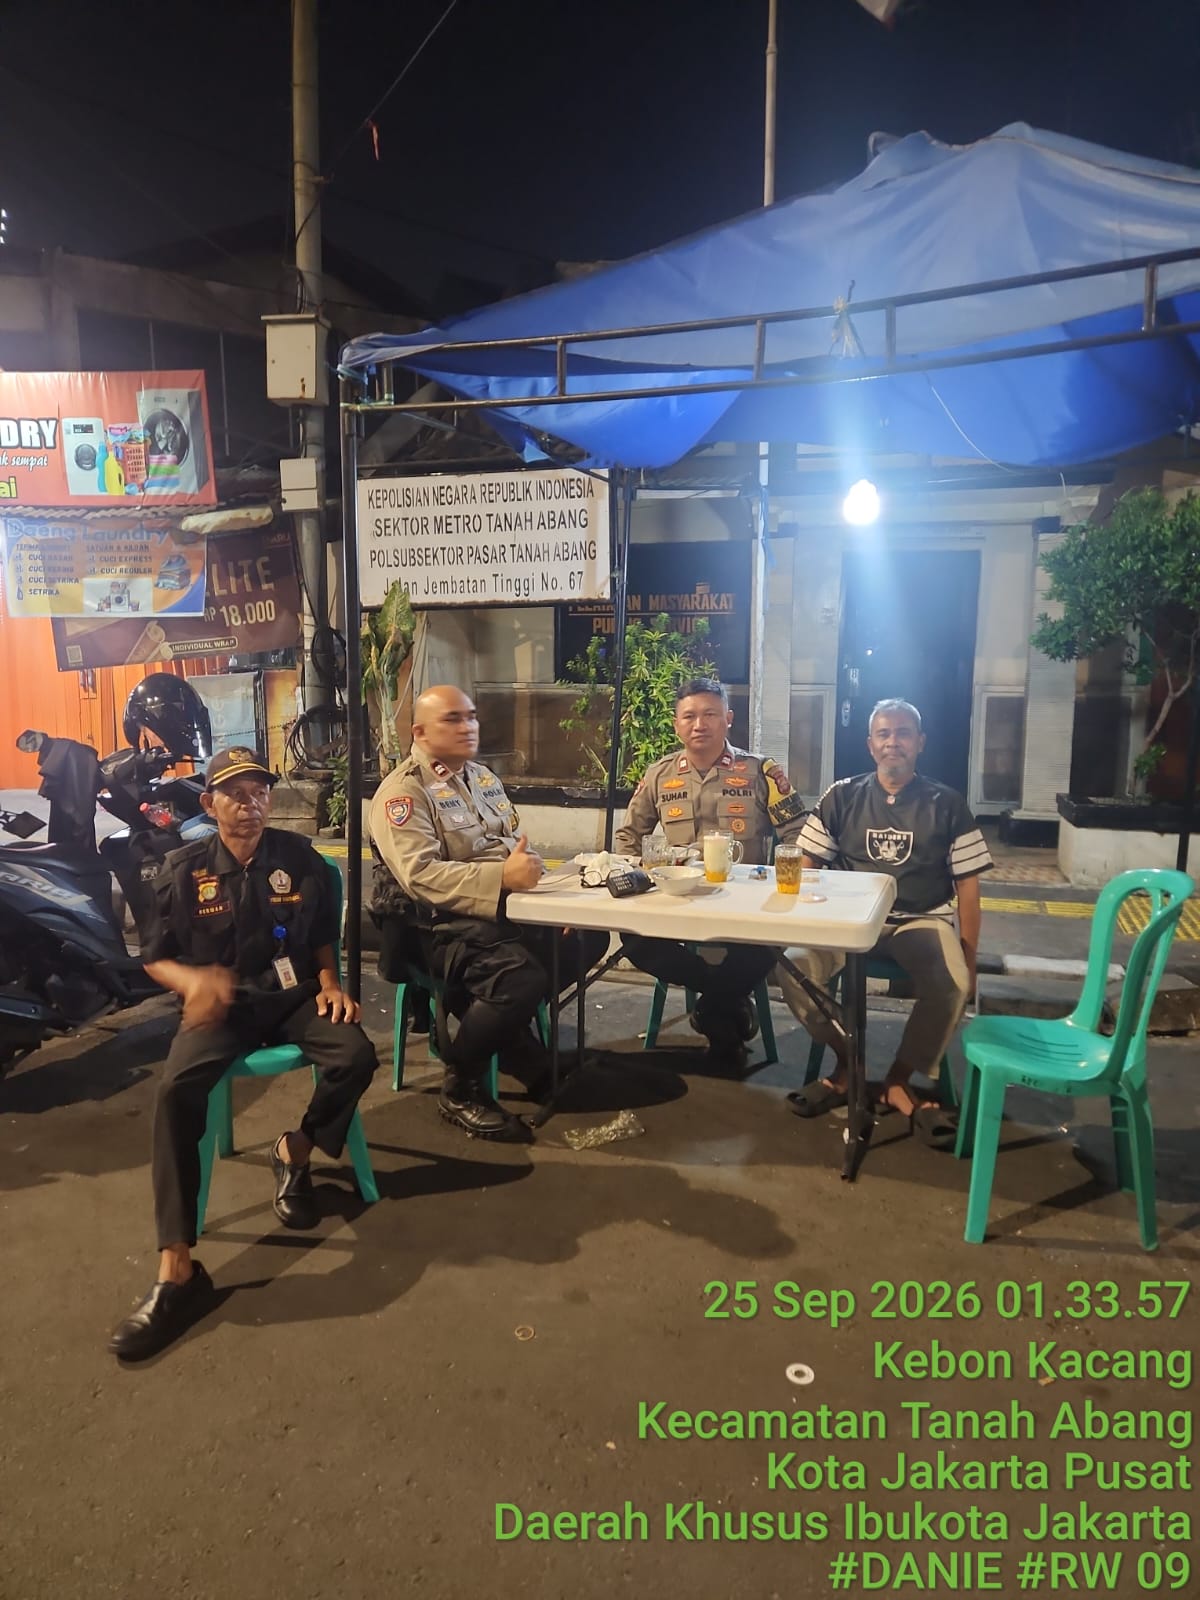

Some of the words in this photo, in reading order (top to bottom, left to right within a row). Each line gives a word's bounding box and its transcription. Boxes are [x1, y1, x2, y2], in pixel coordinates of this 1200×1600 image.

[11, 455, 47, 471] sempat
[368, 486, 430, 509] KEPOLISIAN
[432, 484, 477, 506] NEGARA
[480, 481, 533, 504] REPUBLIK
[536, 477, 594, 500] INDONESIA
[7, 518, 77, 543] Daeng
[82, 522, 169, 545] Laundry
[375, 516, 429, 537] SEKTOR
[433, 514, 482, 535] METRO
[486, 511, 533, 533] TANAH
[537, 508, 588, 530] ABANG
[370, 546, 464, 568] POLSUBSEKTOR
[467, 544, 506, 565] PASAR
[510, 542, 550, 563] TANAH
[553, 540, 597, 562] ABANG
[205, 556, 275, 597] LITE
[384, 577, 418, 596] Jlan
[423, 575, 486, 595] Jembatan
[492, 572, 534, 597] Tinggi
[541, 571, 562, 591] No.
[569, 571, 583, 591] 67
[220, 599, 275, 627] 18.000
[649, 593, 736, 611] MASYARAKAT
[171, 641, 213, 652] INDIVIDUAL
[661, 791, 688, 802] SUHAR
[722, 788, 752, 797] POLRI
